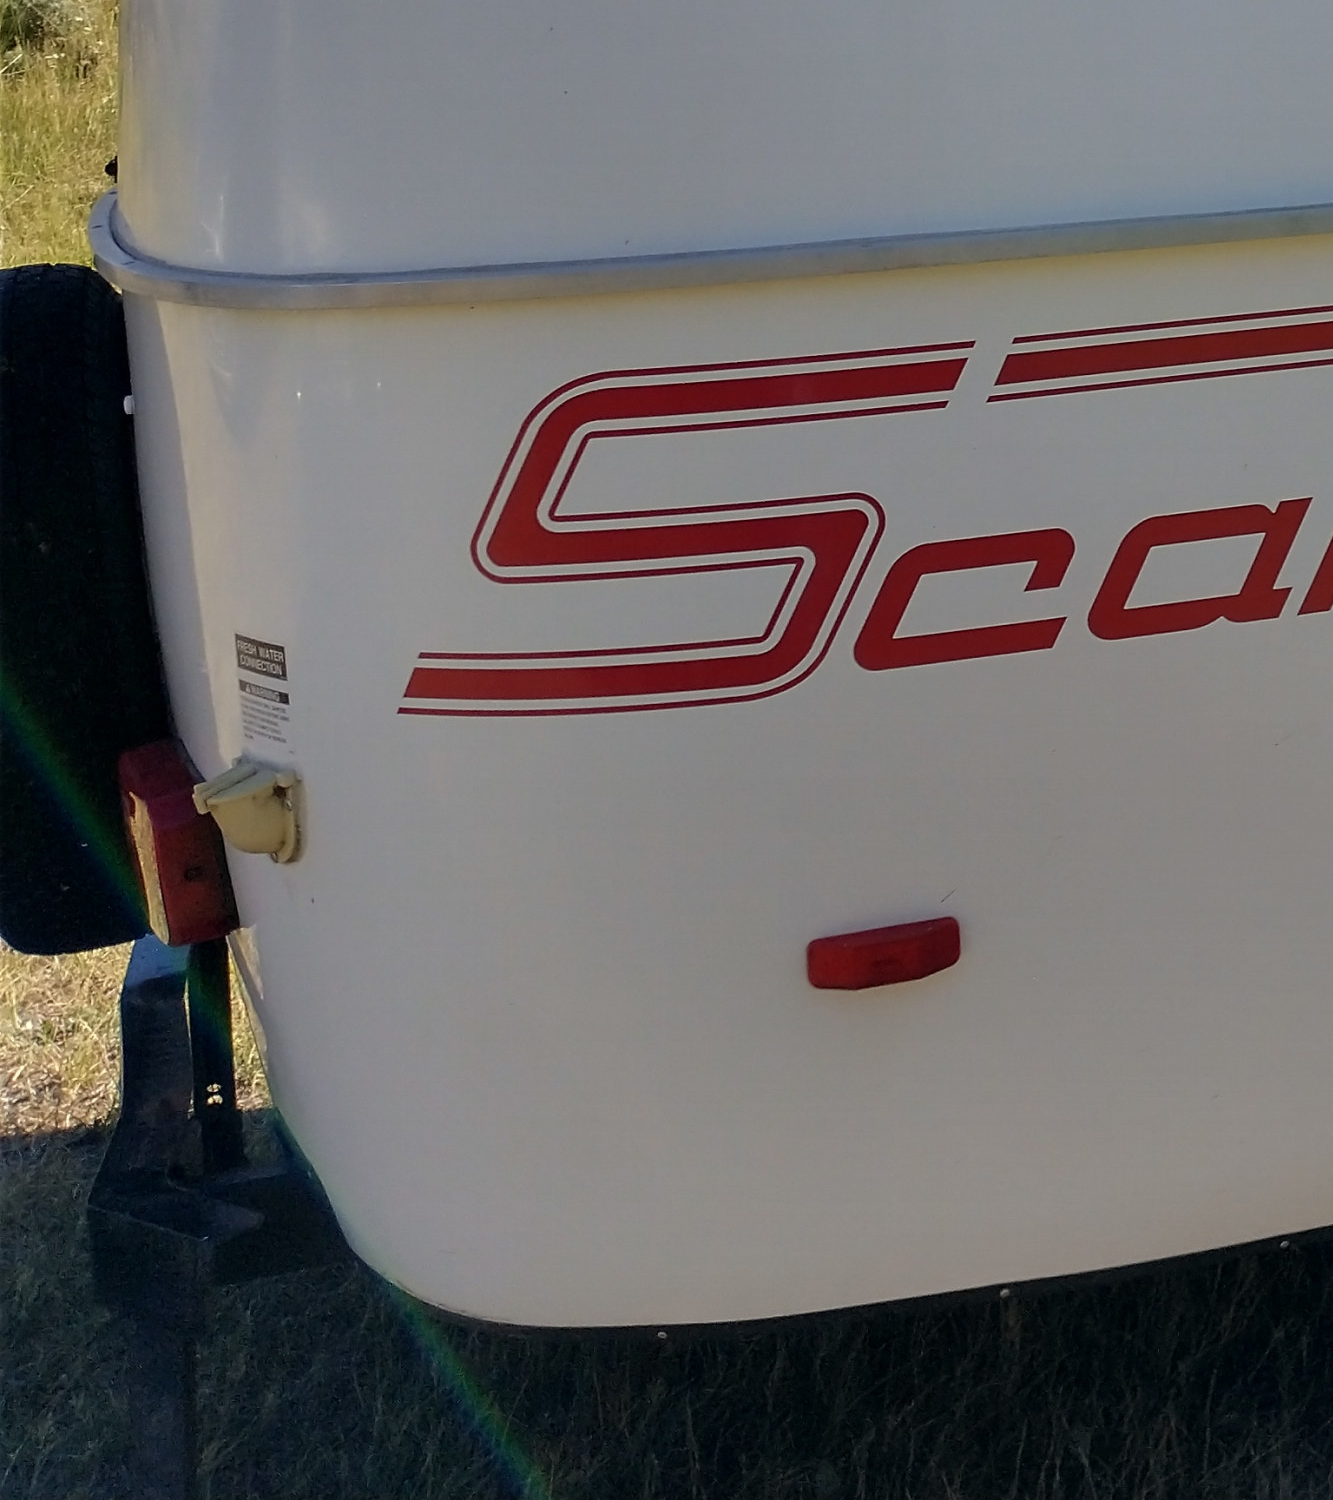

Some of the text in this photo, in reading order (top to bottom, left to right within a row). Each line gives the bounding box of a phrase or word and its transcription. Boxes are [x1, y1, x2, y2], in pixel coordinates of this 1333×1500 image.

[237, 640, 285, 663] FRESH WATER
[239, 654, 283, 676] CONNECTION
[250, 684, 281, 702] WARNING
